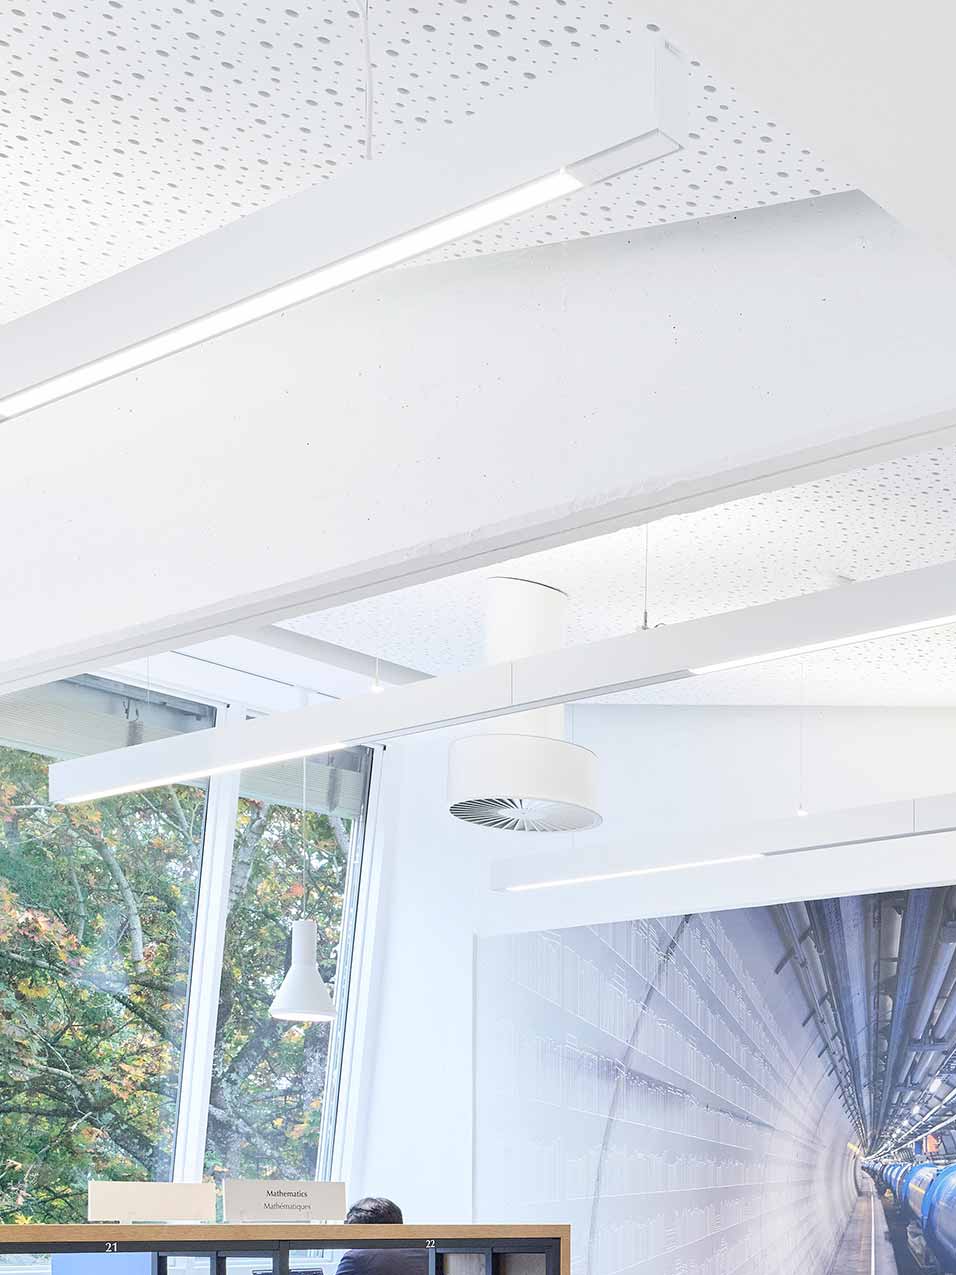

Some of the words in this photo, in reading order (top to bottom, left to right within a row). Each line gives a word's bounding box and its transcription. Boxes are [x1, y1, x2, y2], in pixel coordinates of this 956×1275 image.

[266, 1190, 308, 1198] Mathematics
[263, 1202, 311, 1212] Mathématiques
[104, 1242, 118, 1253] 21
[425, 1239, 436, 1249] 22
